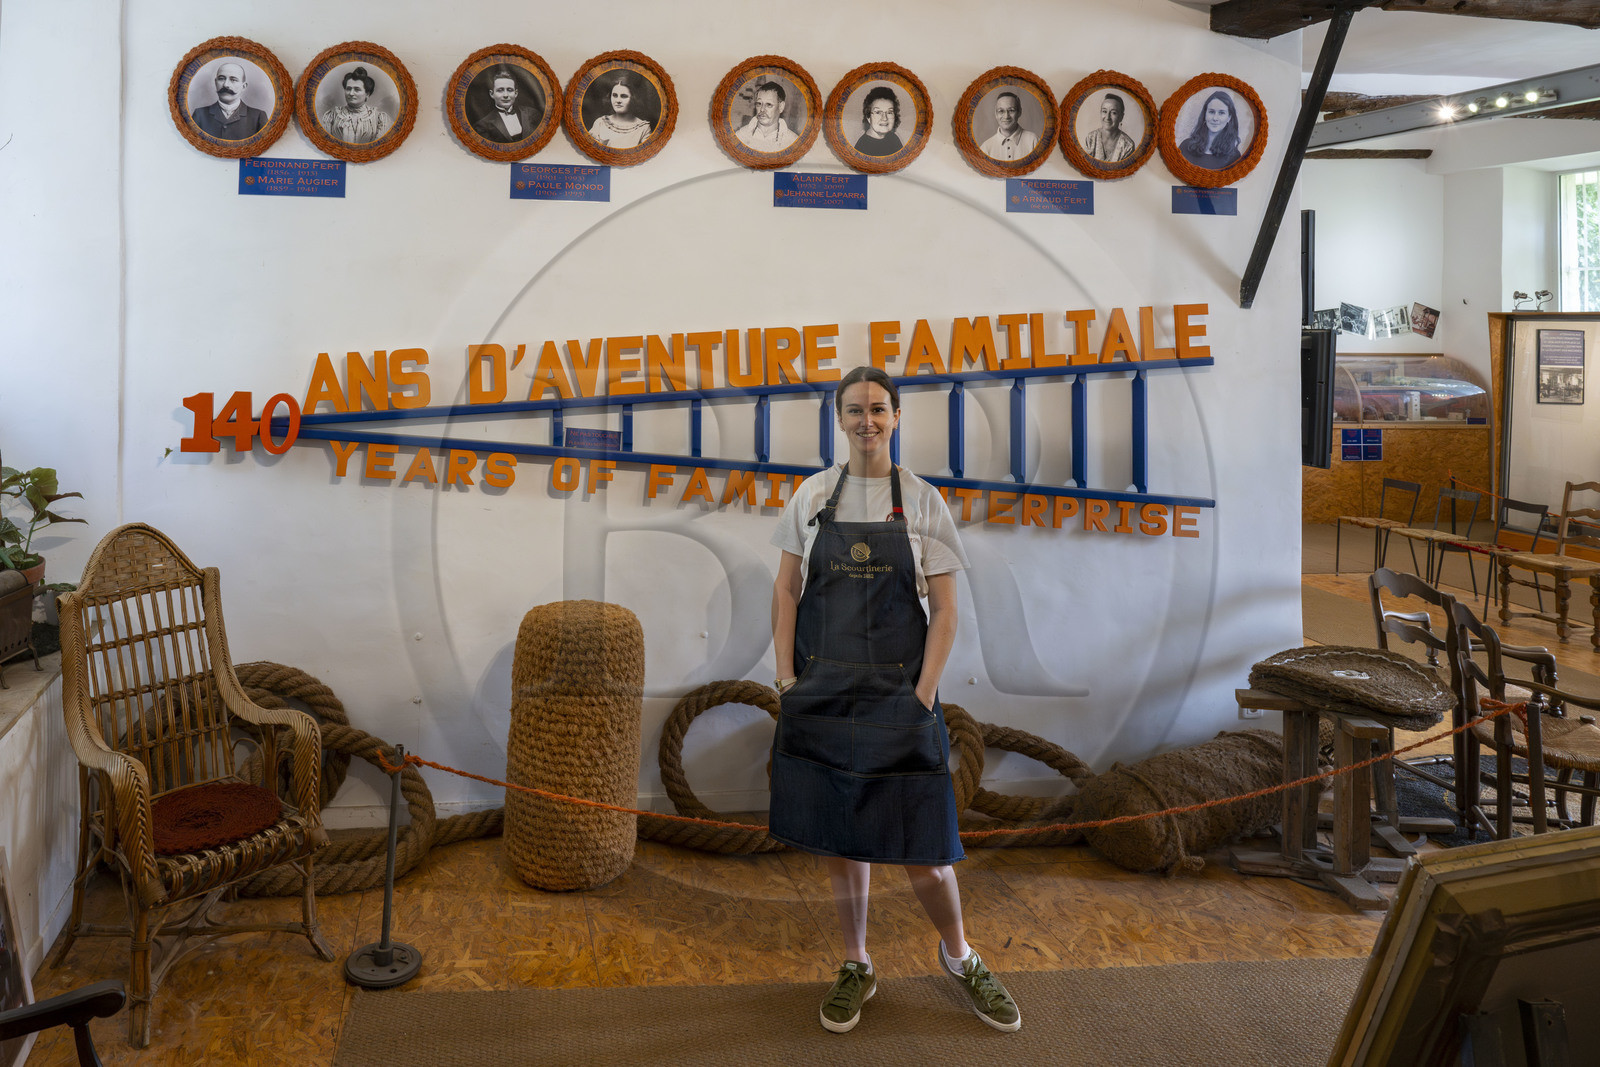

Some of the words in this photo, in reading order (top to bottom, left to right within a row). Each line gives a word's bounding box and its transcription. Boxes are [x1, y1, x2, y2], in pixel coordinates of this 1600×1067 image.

[245, 160, 309, 169] FERDINAND
[312, 161, 341, 170] FERT
[521, 165, 571, 174] GEORGES
[573, 167, 600, 175] FERT
[258, 176, 294, 185] MARIE
[297, 177, 338, 186] AUGIER
[792, 174, 822, 182] ALAIN
[824, 175, 850, 184] FERT
[528, 180, 562, 189] PAULE
[565, 182, 604, 191] MONOD
[784, 189, 825, 198] JEHANNE
[825, 191, 865, 199] LAPARRA
[1022, 195, 1061, 204] ARNAUD
[1064, 196, 1087, 204] FERT
[180, 391, 301, 455] 140
[302, 348, 432, 415] ANS
[468, 324, 841, 405] D'AVENTURE
[869, 303, 1211, 377] FAMILIALE
[328, 439, 518, 488] YEARS
[552, 457, 617, 494] OF
[830, 560, 839, 571] La
